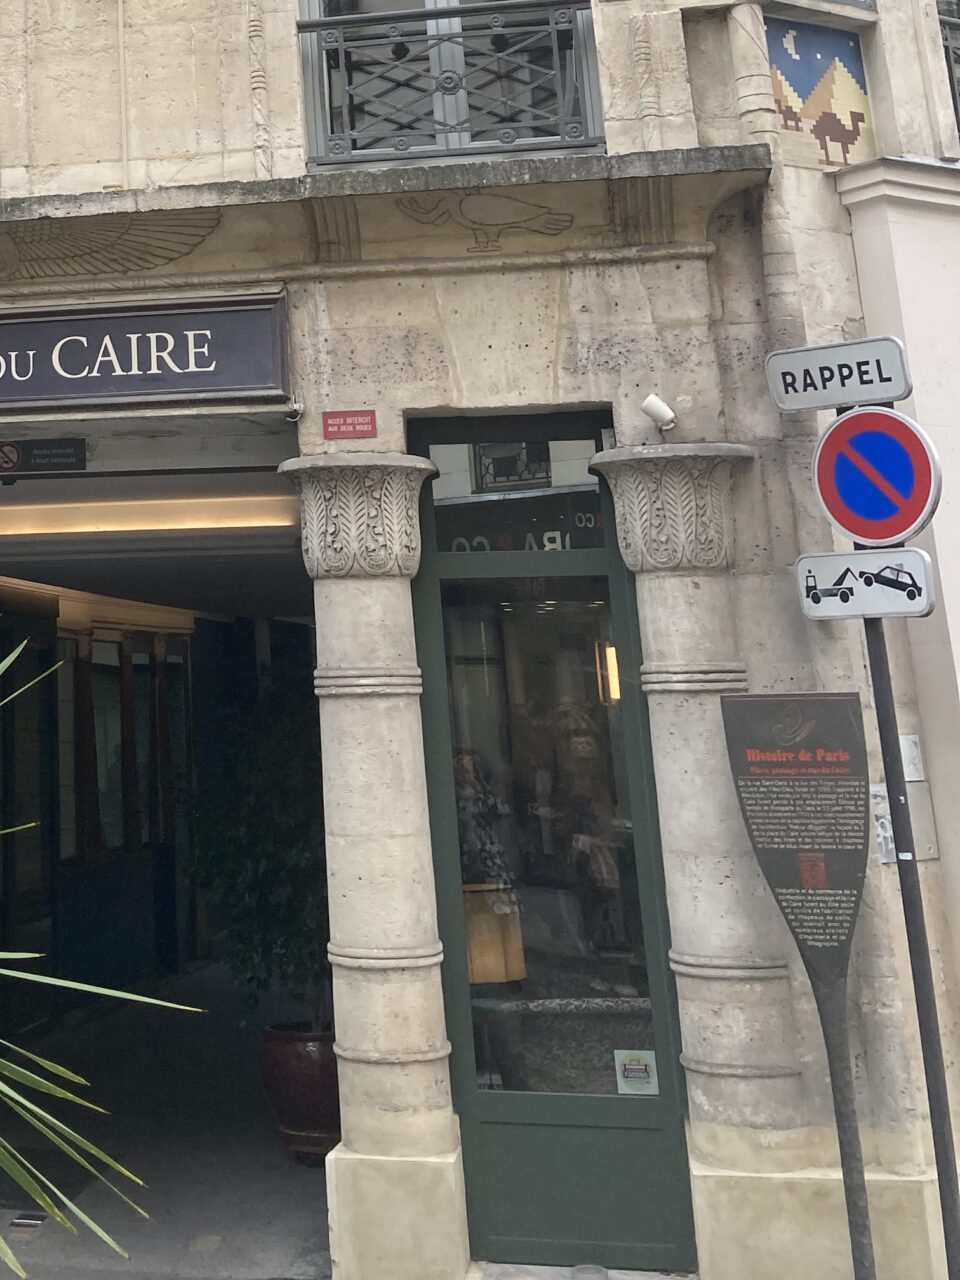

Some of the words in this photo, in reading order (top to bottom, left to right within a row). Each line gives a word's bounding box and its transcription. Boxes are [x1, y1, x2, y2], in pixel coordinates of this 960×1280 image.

[51, 329, 216, 380] CAIRE
[781, 359, 893, 395] RAPPEL
[746, 749, 795, 762] Histoire
[798, 748, 813, 762] de
[816, 748, 850, 762] Paris
